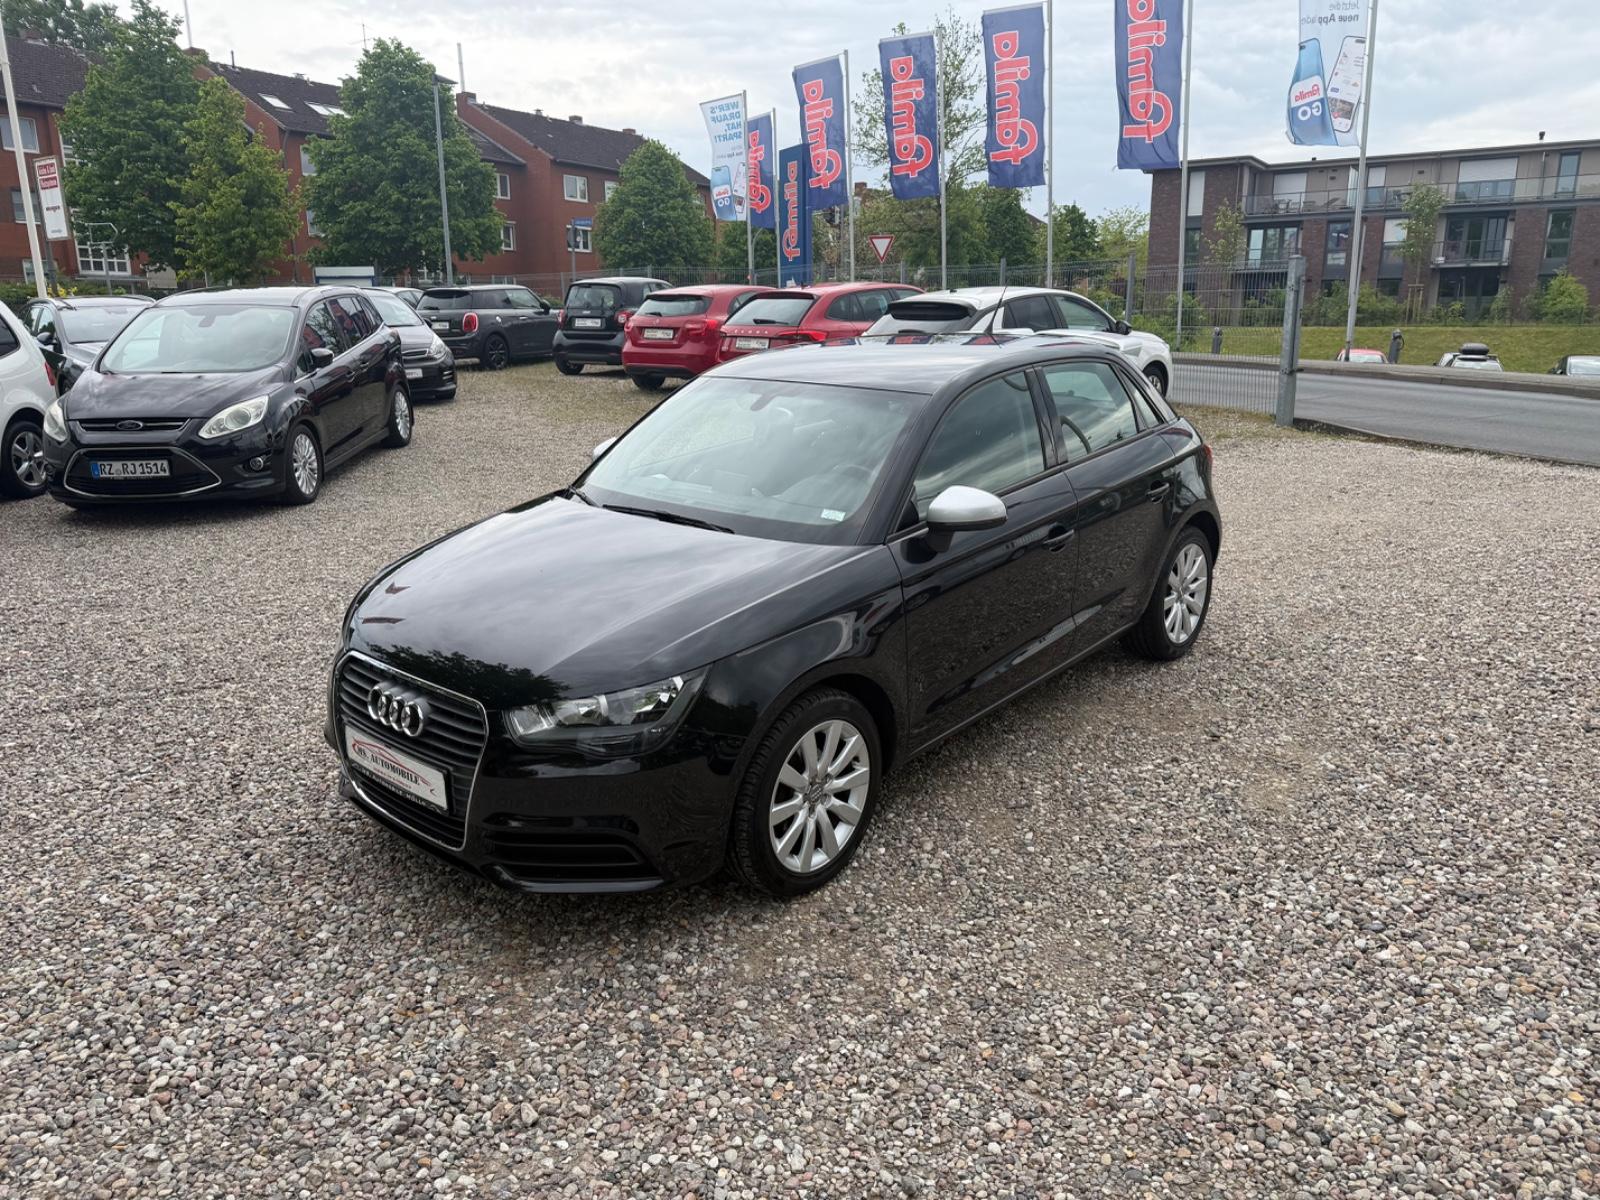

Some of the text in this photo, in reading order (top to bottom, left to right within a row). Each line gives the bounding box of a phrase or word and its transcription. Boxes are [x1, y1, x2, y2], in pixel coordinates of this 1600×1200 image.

[783, 160, 800, 262] famila
[100, 462, 167, 475] RZ RJ 1514
